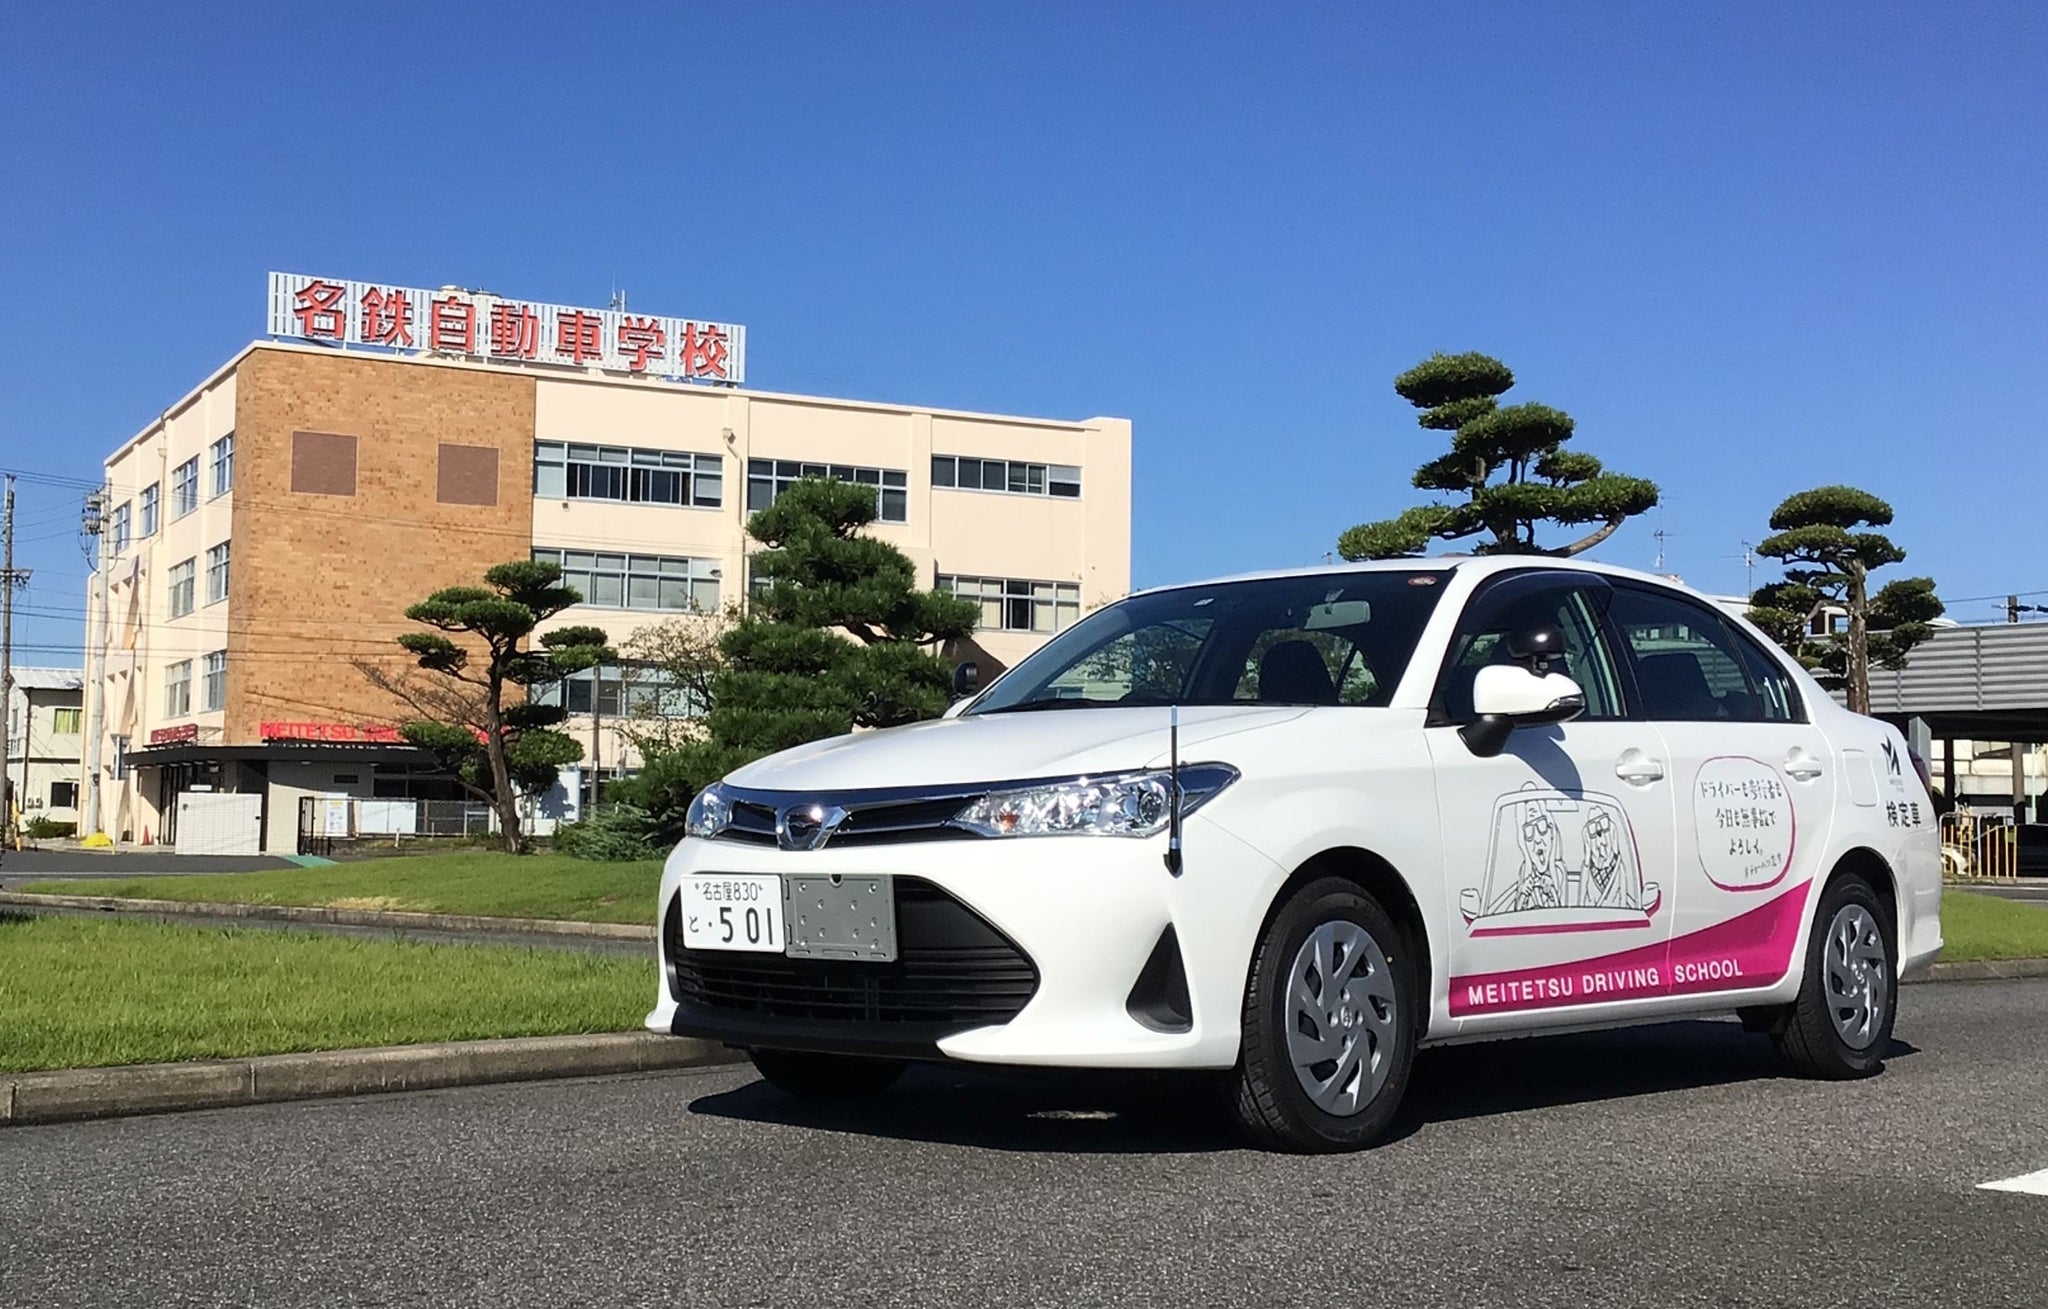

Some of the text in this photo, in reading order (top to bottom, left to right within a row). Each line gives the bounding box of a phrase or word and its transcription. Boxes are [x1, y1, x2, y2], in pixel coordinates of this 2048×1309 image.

[294, 280, 728, 379] 名鉄自動車学校
[1886, 801, 1921, 827] 検定車
[703, 881, 758, 901] 名古屋830
[1468, 958, 1743, 1006] MEITETSU DRIVING SCHOOL
